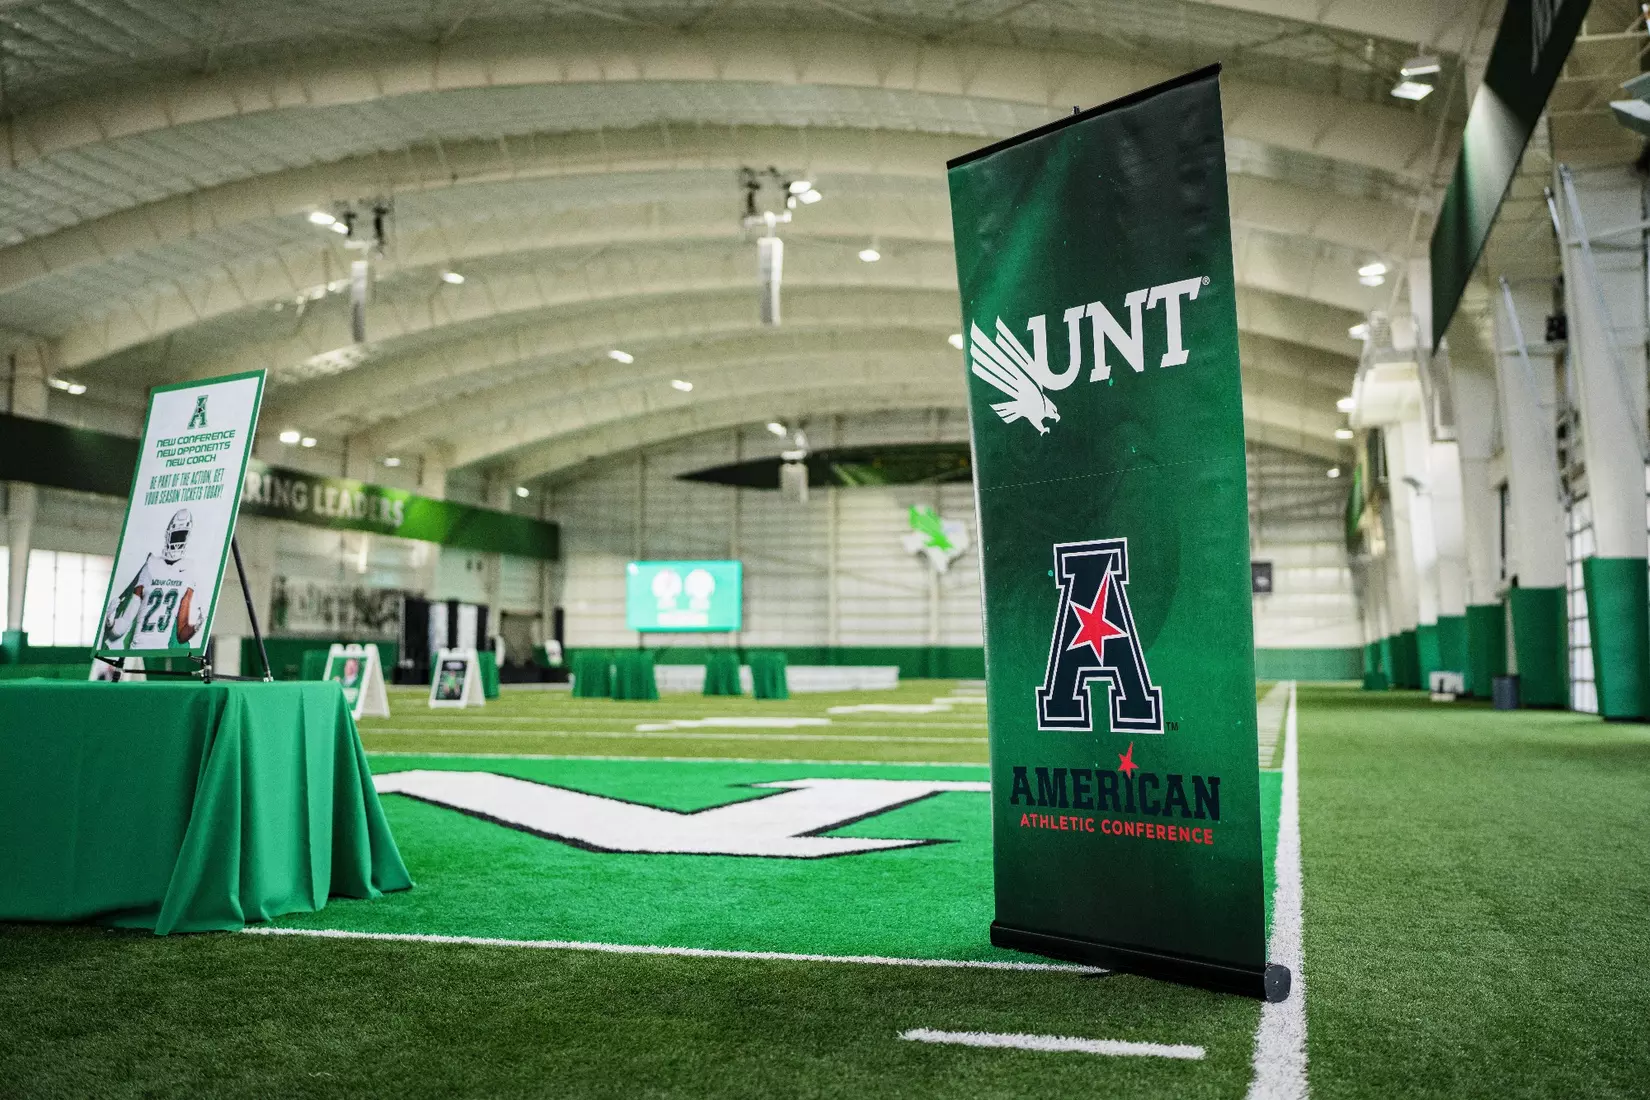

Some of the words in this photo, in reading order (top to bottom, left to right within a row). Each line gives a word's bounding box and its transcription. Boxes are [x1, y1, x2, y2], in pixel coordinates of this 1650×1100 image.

[1026, 276, 1202, 390] UNT
[156, 438, 177, 448] NEW
[177, 429, 236, 445] CONFERENCE
[156, 448, 177, 459] NEW
[177, 441, 231, 455] OPPONENTS
[165, 457, 186, 468] NEW
[186, 454, 217, 465] COACH
[149, 476, 158, 490] BE
[158, 474, 172, 488] PART
[171, 473, 180, 487] OF
[180, 472, 191, 486] THE
[213, 468, 225, 483] GET
[144, 491, 160, 506] YOUR
[158, 488, 181, 504] SEASON
[180, 486, 204, 502] TICKETS
[140, 587, 179, 633] 23
[1010, 766, 1221, 821] AMERICAN
[1020, 812, 1096, 834] ATHLETIC
[1100, 819, 1214, 845] CONFERENCE
